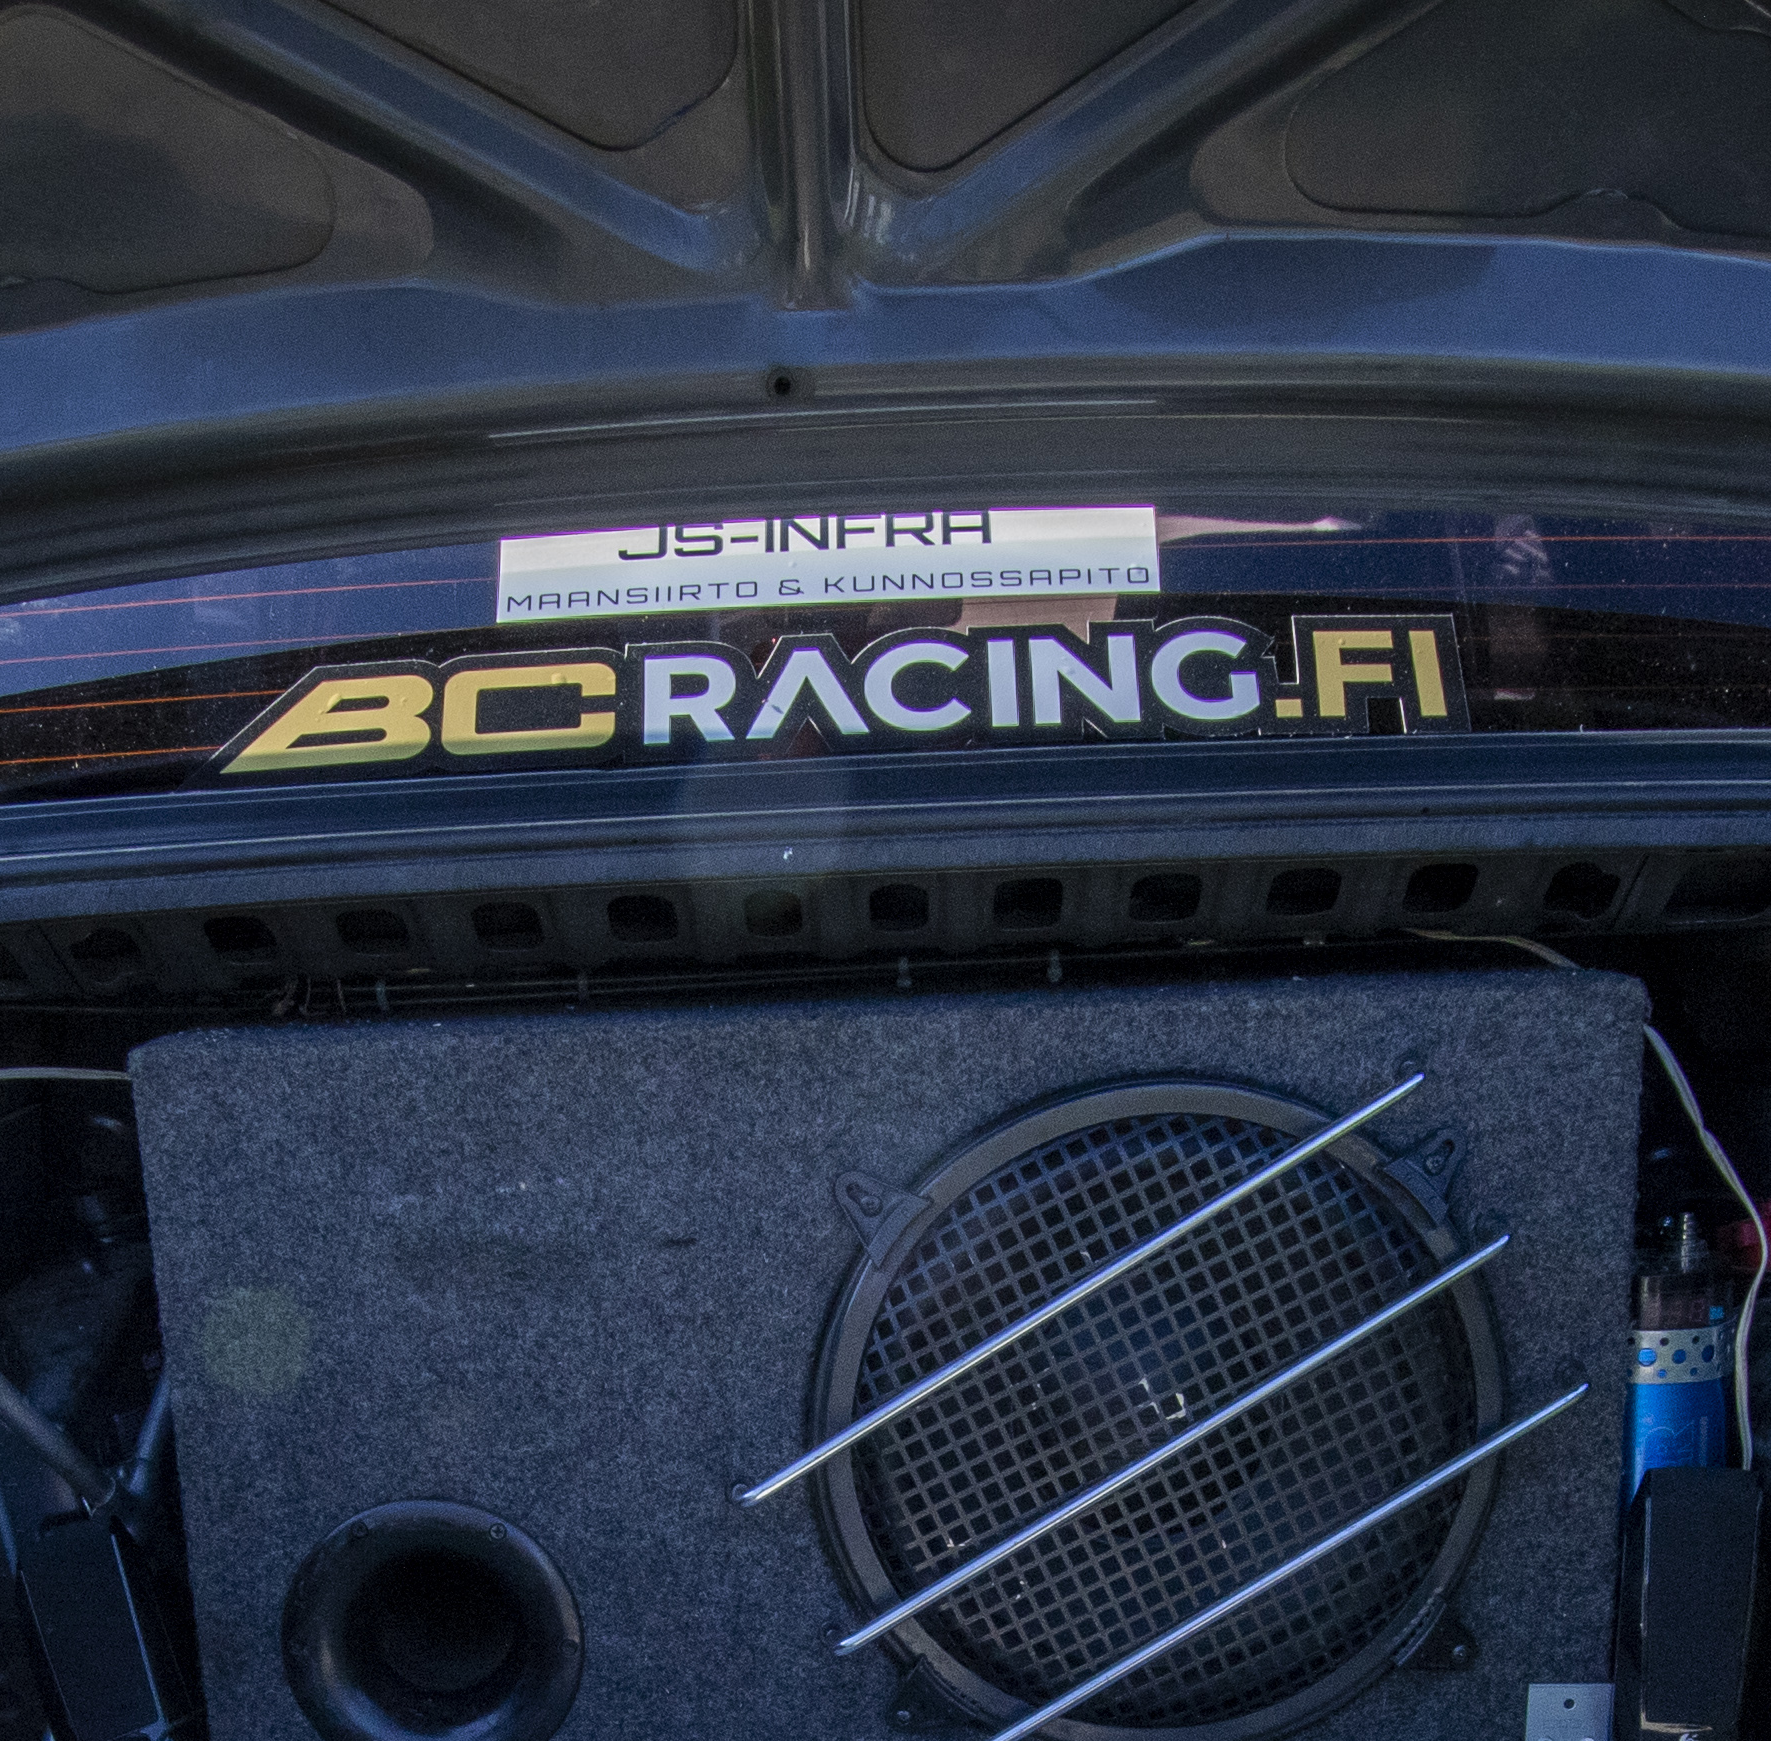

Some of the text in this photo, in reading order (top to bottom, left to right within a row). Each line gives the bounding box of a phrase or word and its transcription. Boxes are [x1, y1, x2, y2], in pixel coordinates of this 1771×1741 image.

[618, 511, 992, 561] JS-INFRA
[506, 566, 1150, 613] MAANSIIRTO & KUNNOSSAPITO
